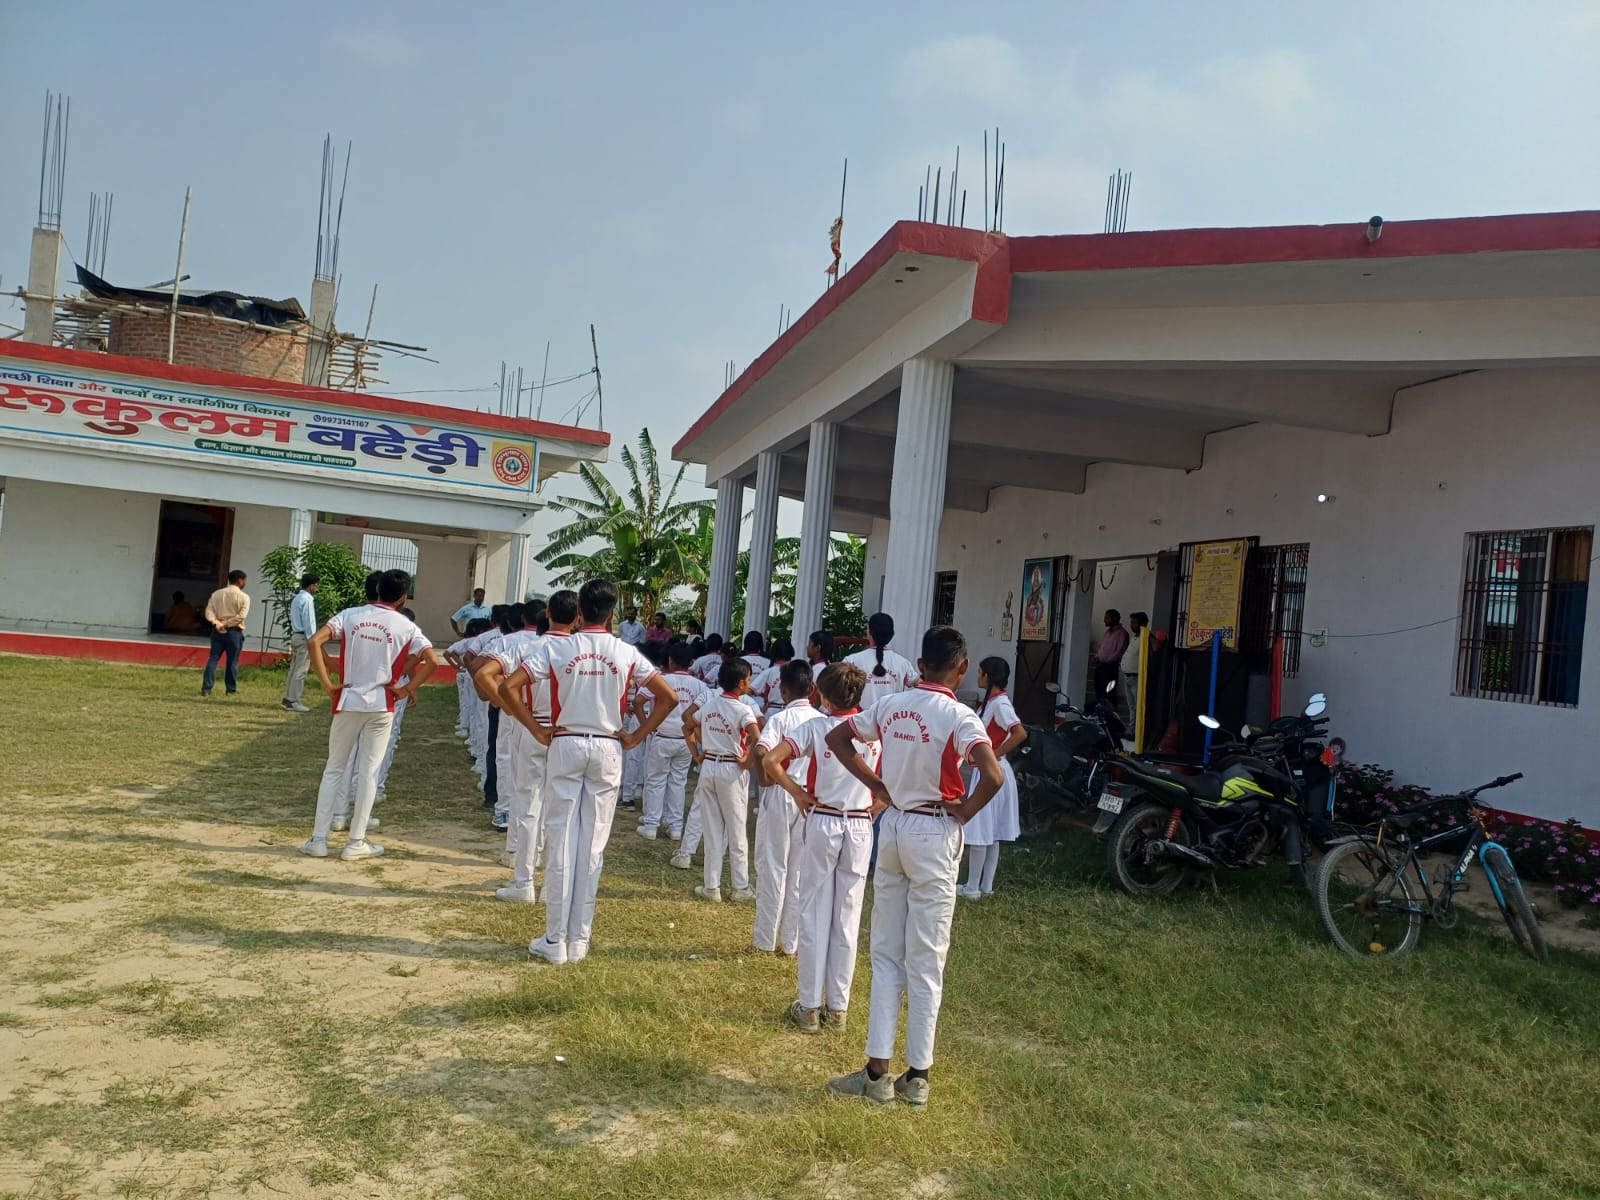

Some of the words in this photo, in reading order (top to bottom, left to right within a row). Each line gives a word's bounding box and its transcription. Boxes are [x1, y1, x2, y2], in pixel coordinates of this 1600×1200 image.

[0, 372, 32, 383] च्छी
[77, 381, 107, 392] और
[152, 392, 174, 402] का
[243, 402, 292, 418] विकास
[321, 415, 369, 428] 9973141167
[305, 424, 486, 474] बहेड़ी
[565, 653, 618, 675] GURUKULAM
